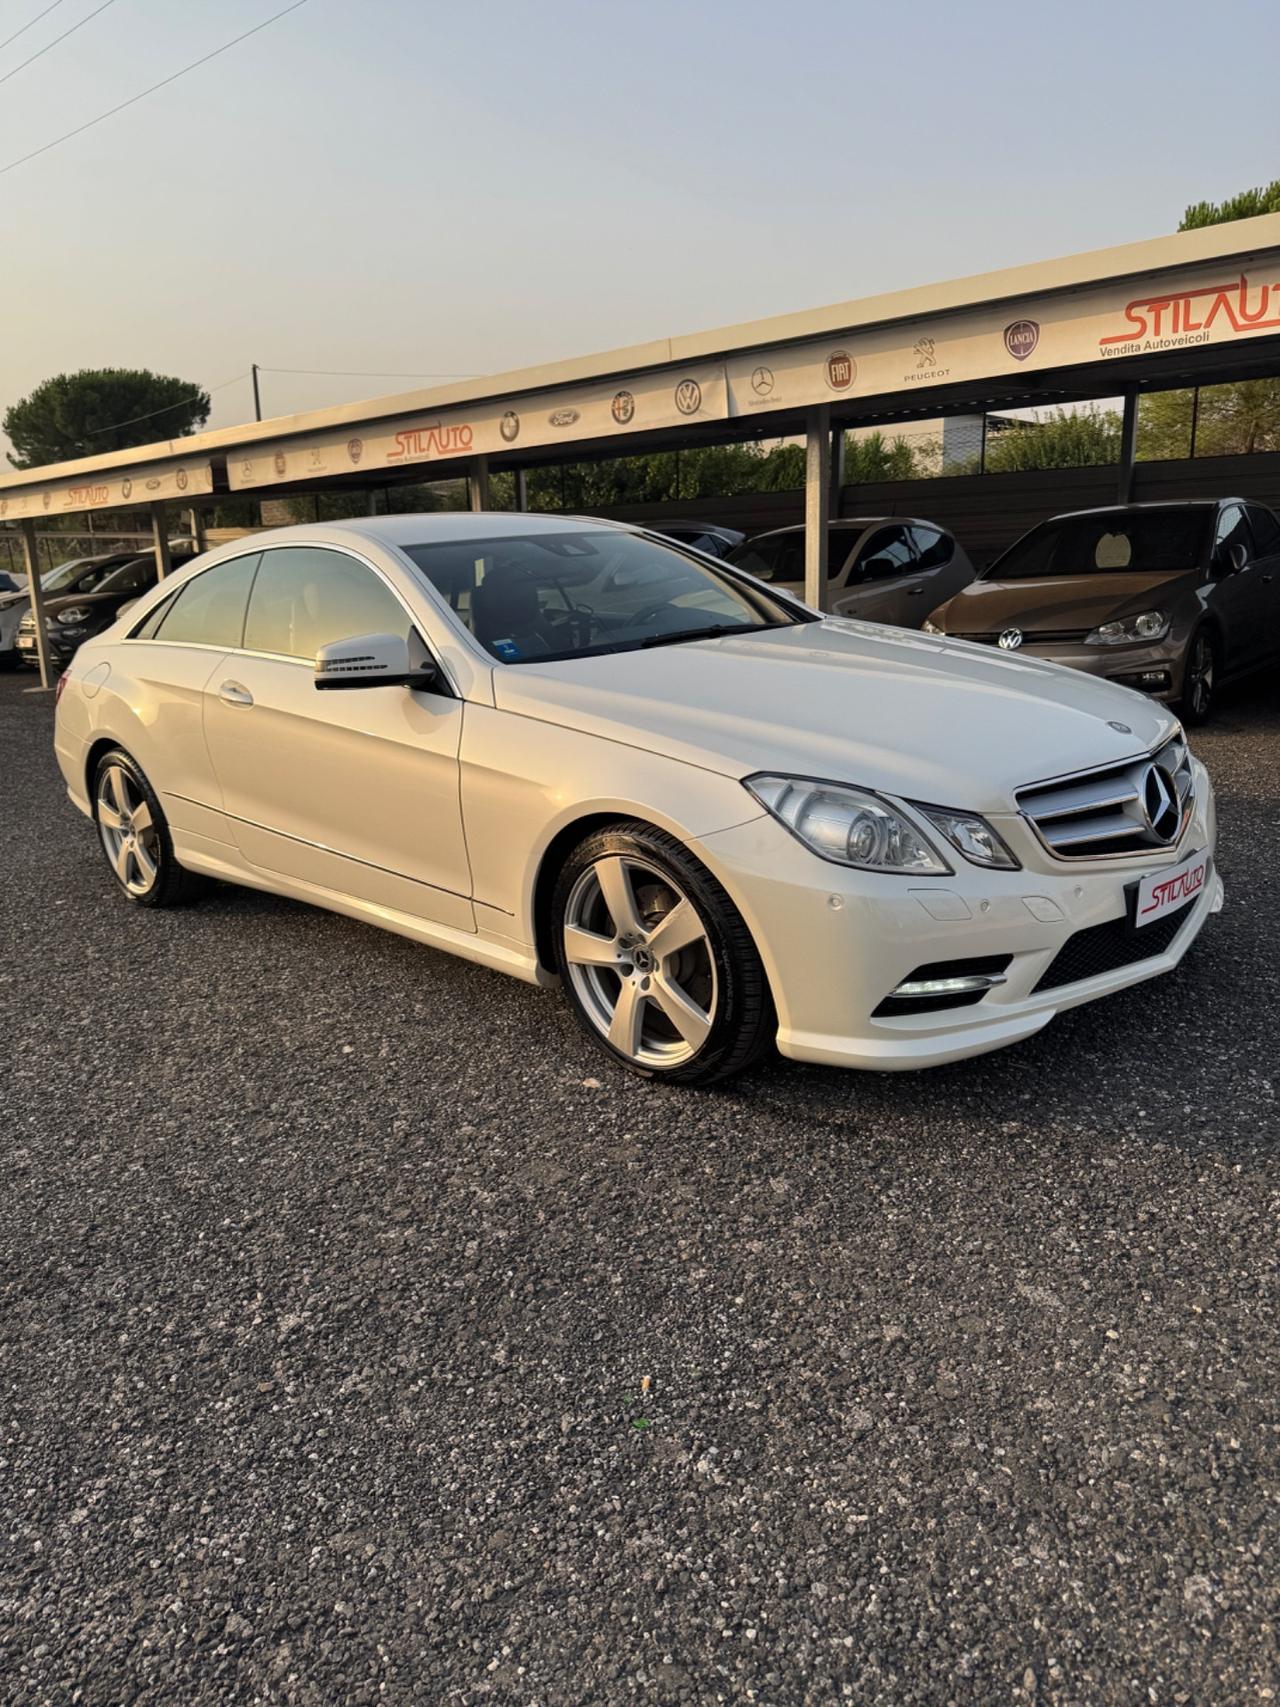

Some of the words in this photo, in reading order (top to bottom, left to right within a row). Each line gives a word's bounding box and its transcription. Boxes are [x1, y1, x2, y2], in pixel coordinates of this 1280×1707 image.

[1009, 331, 1034, 346] LANCIA
[1099, 343, 1141, 357] Vendita
[1143, 331, 1210, 351] Autoveicoli
[831, 362, 850, 383] FIAT
[903, 368, 950, 382] PEUGEOT
[553, 411, 575, 425] Ford
[386, 420, 473, 457] STILAUTO
[1141, 864, 1205, 915] STILAUTO
